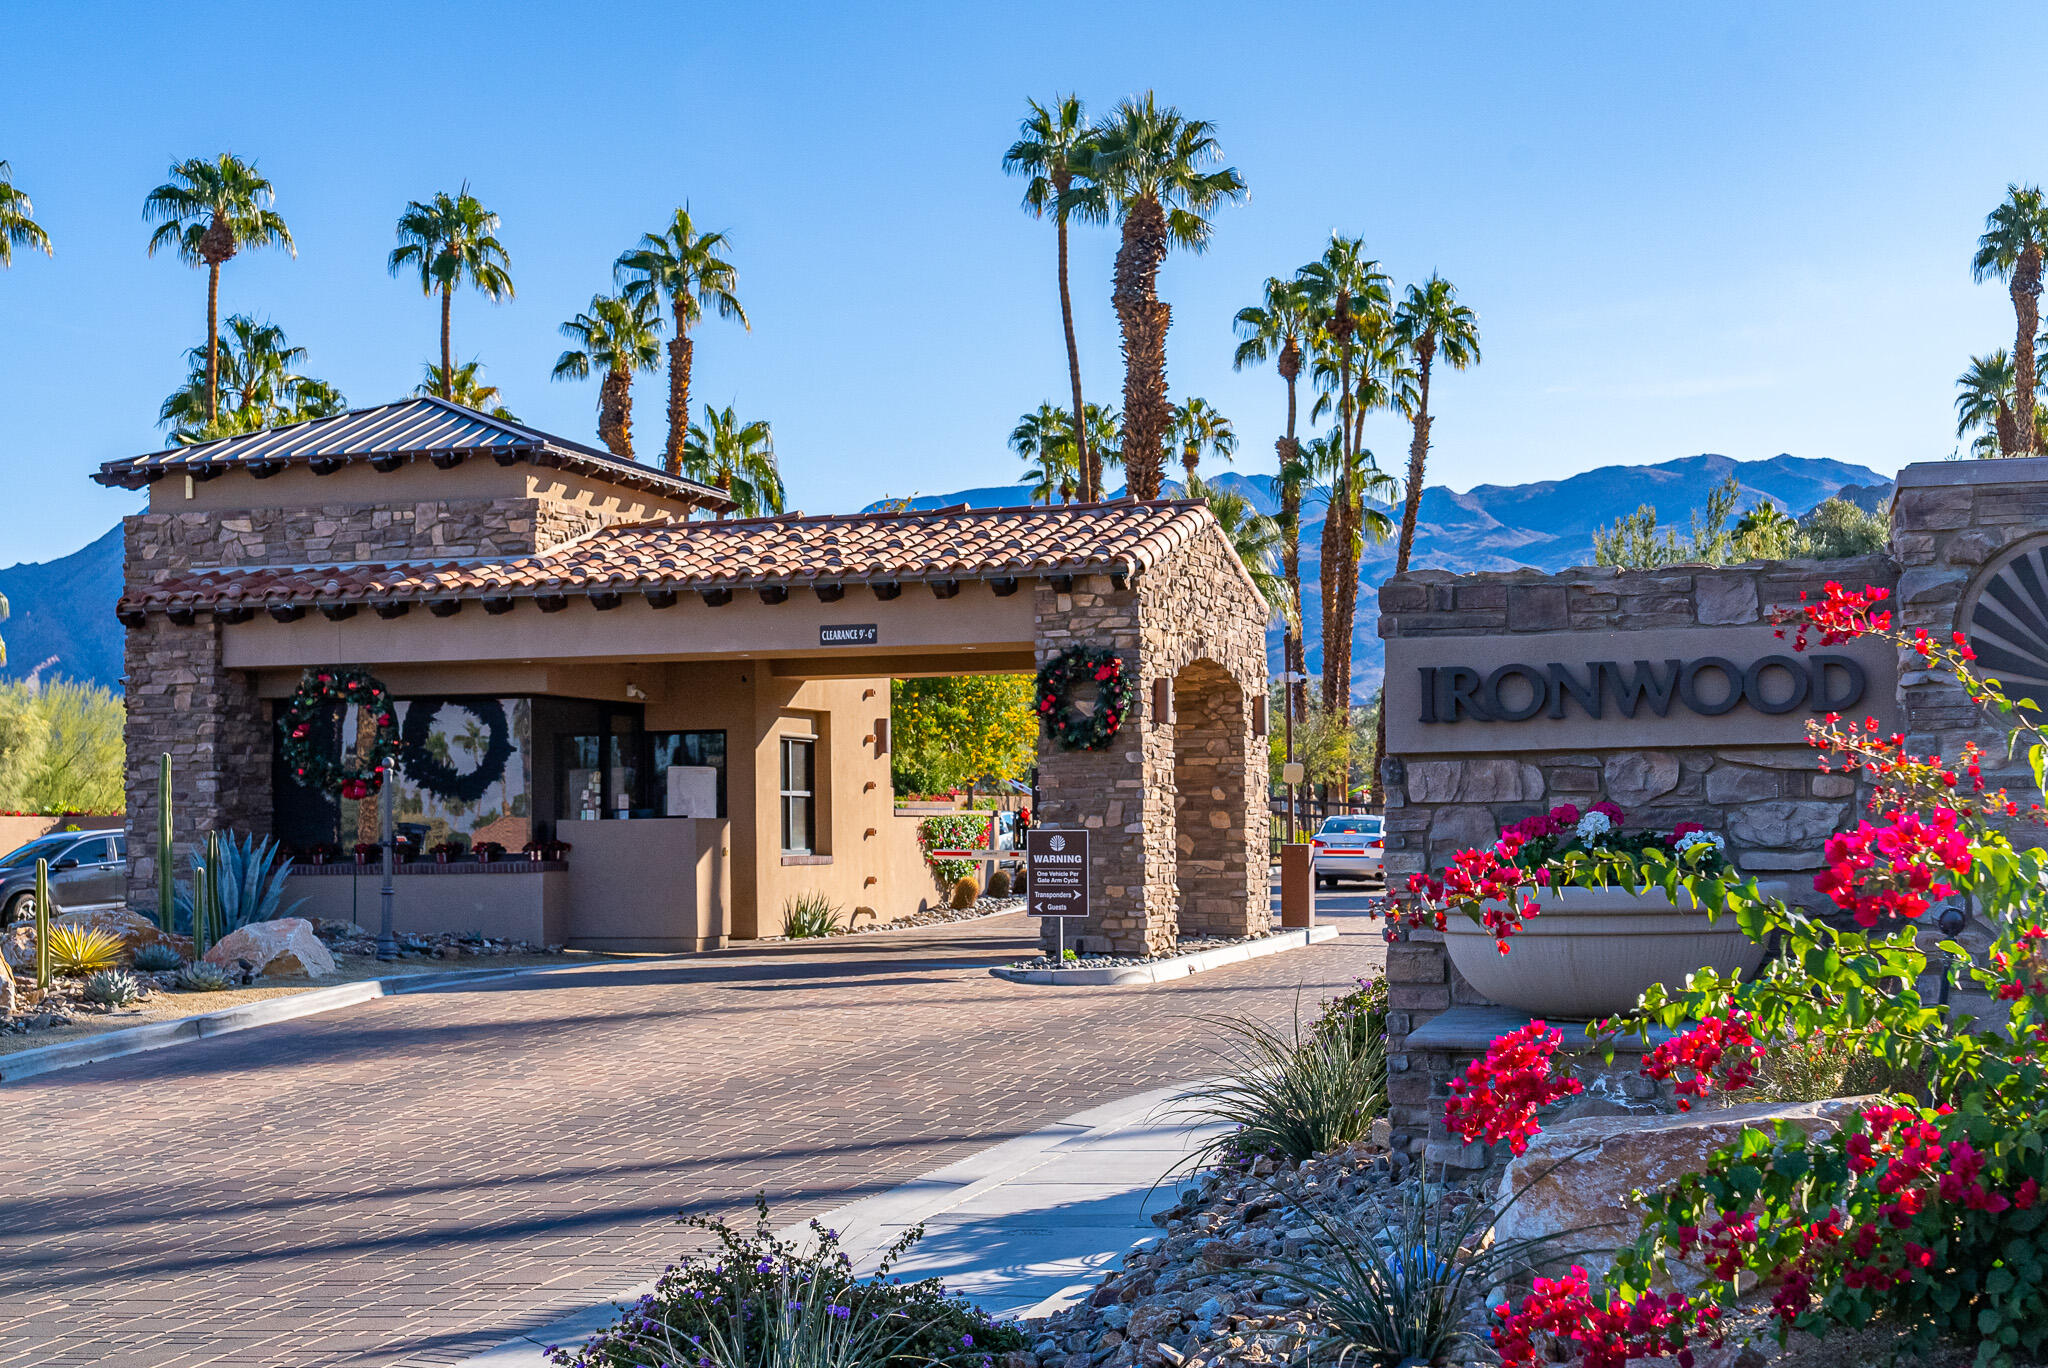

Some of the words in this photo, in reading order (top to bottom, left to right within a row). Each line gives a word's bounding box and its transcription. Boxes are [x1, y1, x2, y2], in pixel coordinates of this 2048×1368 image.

[822, 630, 858, 640] CLEARANCE
[1417, 654, 1866, 723] IRONWOOD
[1033, 855, 1082, 863] WARNING
[1034, 891, 1072, 899] Transponders
